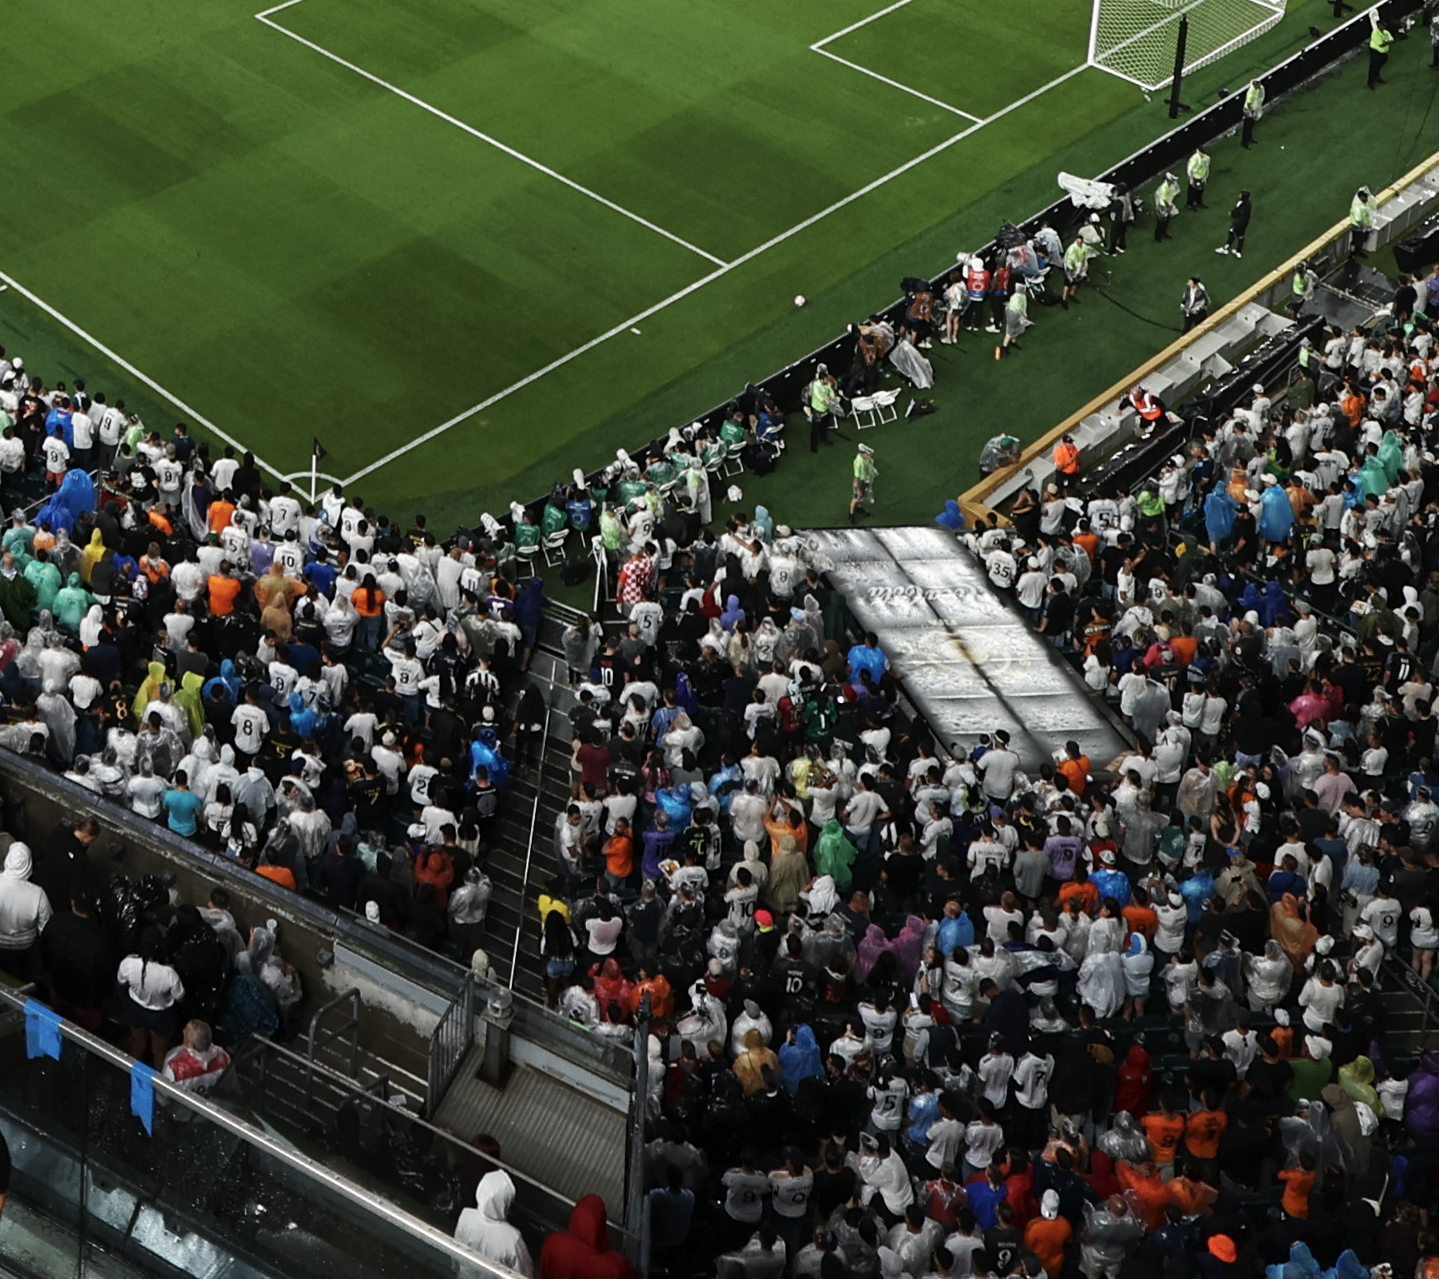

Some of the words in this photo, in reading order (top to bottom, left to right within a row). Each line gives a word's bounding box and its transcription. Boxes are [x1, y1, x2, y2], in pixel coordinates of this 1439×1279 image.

[993, 562, 1010, 577] 35
[600, 669, 614, 686] 10
[243, 720, 252, 736] 8
[1382, 914, 1393, 929] 9
